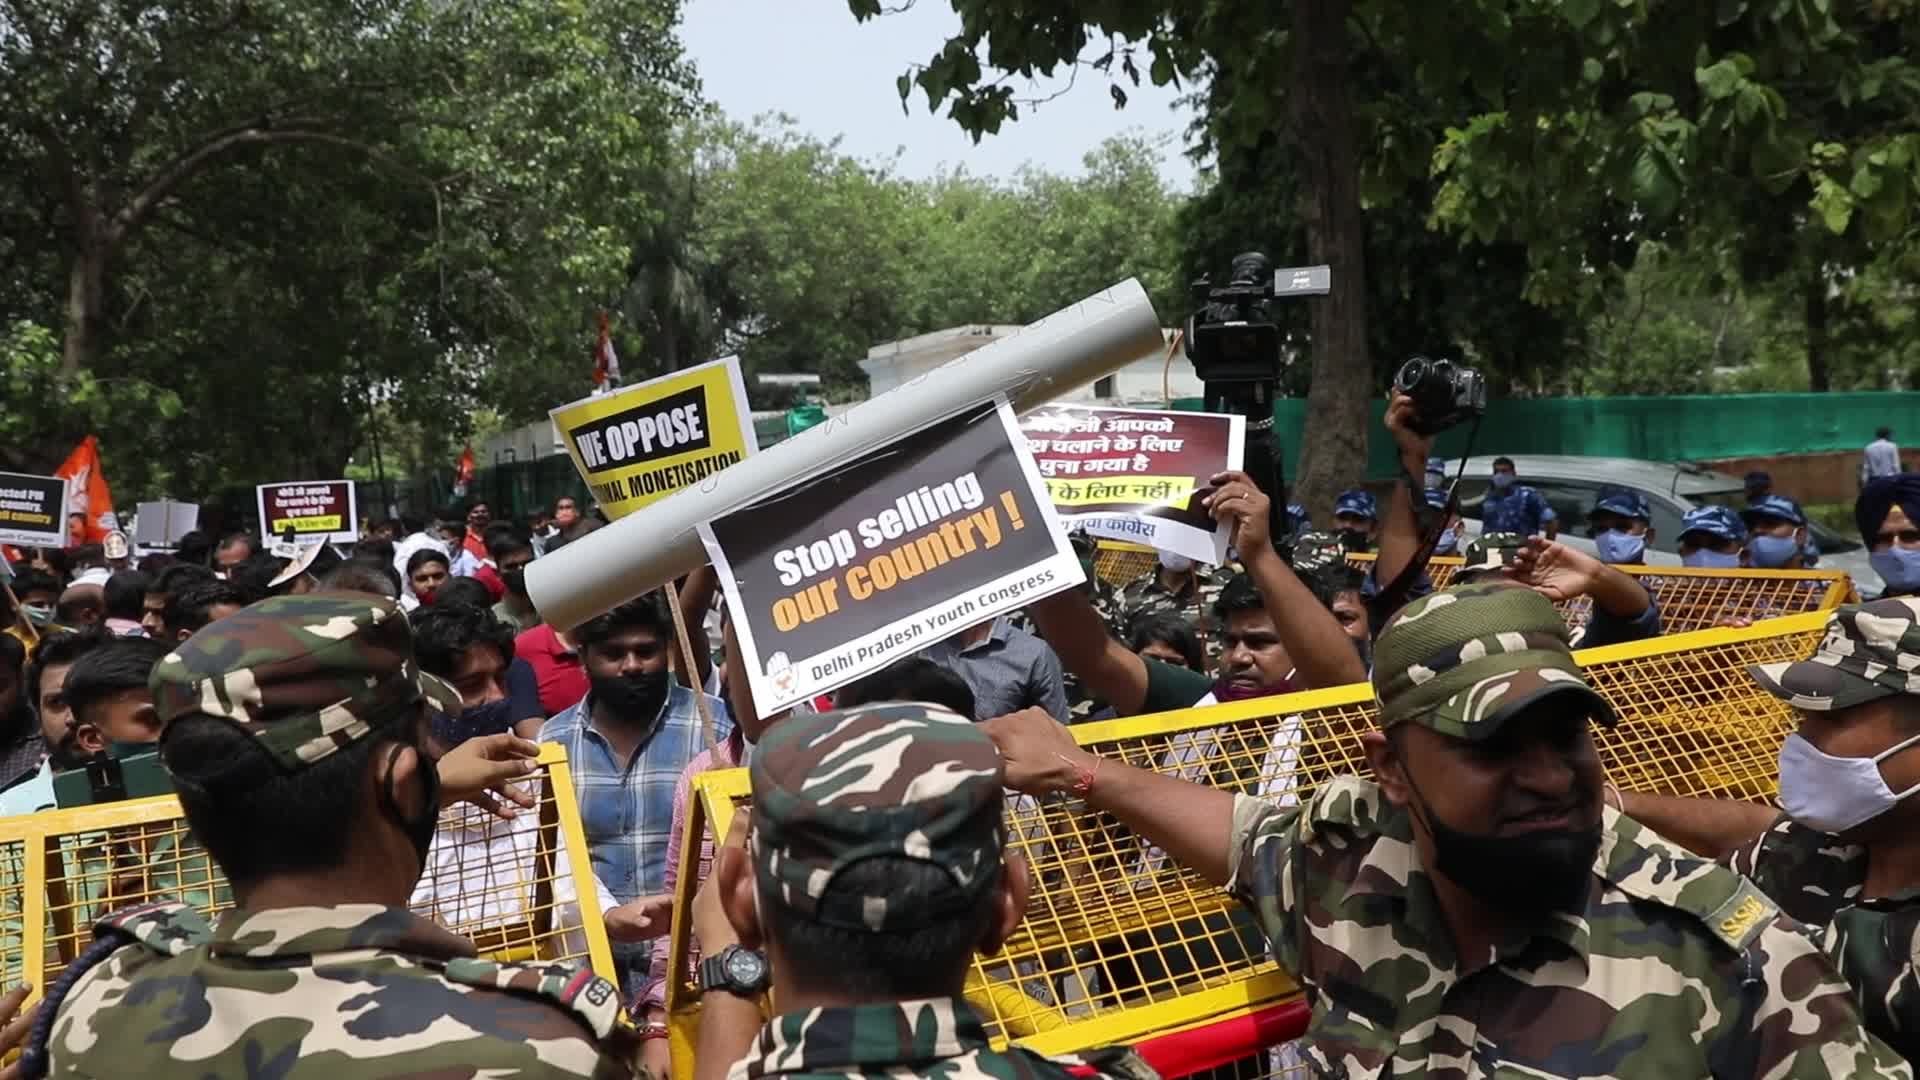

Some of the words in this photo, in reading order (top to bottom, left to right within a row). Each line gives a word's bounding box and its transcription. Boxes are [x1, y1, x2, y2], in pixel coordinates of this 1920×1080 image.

[575, 430, 607, 468] WE
[605, 403, 704, 461] OPPOSE
[1025, 439, 1051, 453] श
[1052, 435, 1111, 454] चलाने
[1114, 434, 1138, 452] के
[1140, 434, 1185, 452] लिए
[1104, 416, 1175, 433] आपको
[627, 450, 742, 498] MONETISATION
[1039, 459, 1081, 477] चुना
[1083, 458, 1131, 473] गया
[1132, 453, 1151, 472] है
[1059, 482, 1082, 500] के
[1086, 481, 1129, 499] लिए
[1132, 480, 1174, 499] नहीं
[773, 527, 857, 588] Stop
[858, 471, 986, 550] selling
[770, 577, 841, 633] our
[845, 505, 1002, 601] country
[999, 490, 1025, 530] !
[811, 652, 854, 681] Delhi
[857, 623, 924, 667] Pradesh
[925, 599, 976, 632] Youth
[978, 567, 1056, 613] Congress
